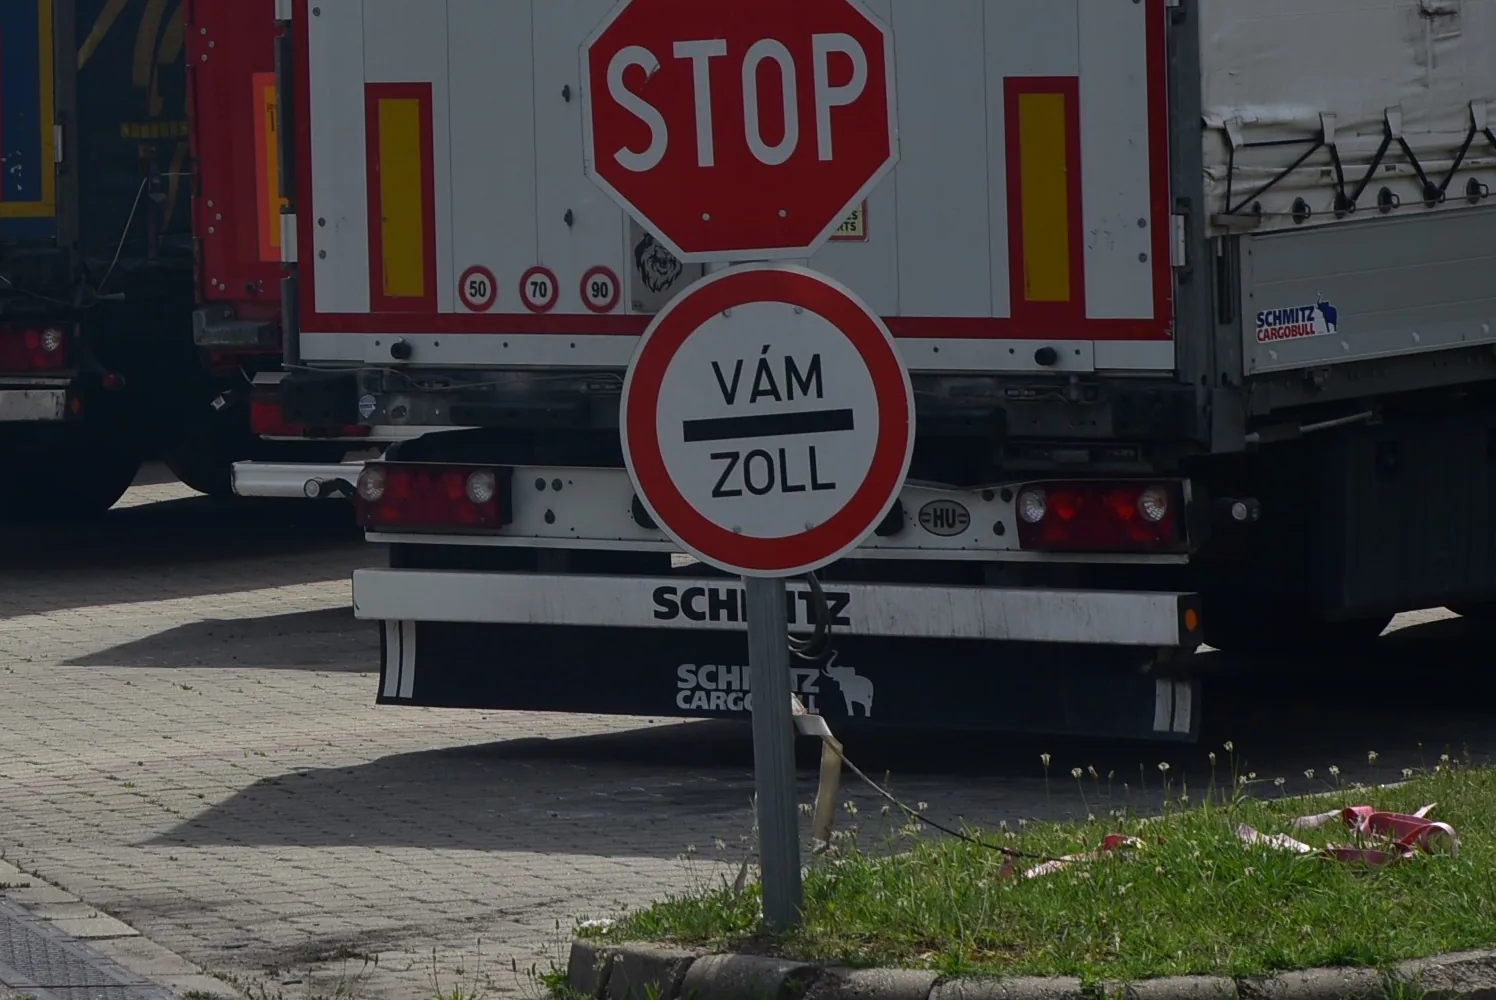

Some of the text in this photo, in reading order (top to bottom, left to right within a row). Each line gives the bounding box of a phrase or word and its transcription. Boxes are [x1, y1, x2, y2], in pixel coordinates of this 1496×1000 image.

[607, 32, 868, 172] STOP
[469, 281, 486, 298] 50
[530, 281, 547, 298] 70
[591, 281, 608, 298] 90
[1257, 306, 1315, 328] SCHMITZ
[1257, 323, 1315, 342] CARGOBULL
[711, 345, 823, 404] VÁM
[711, 445, 835, 498] ZOLL
[933, 508, 956, 528] HU
[653, 586, 850, 626] SCHITZ
